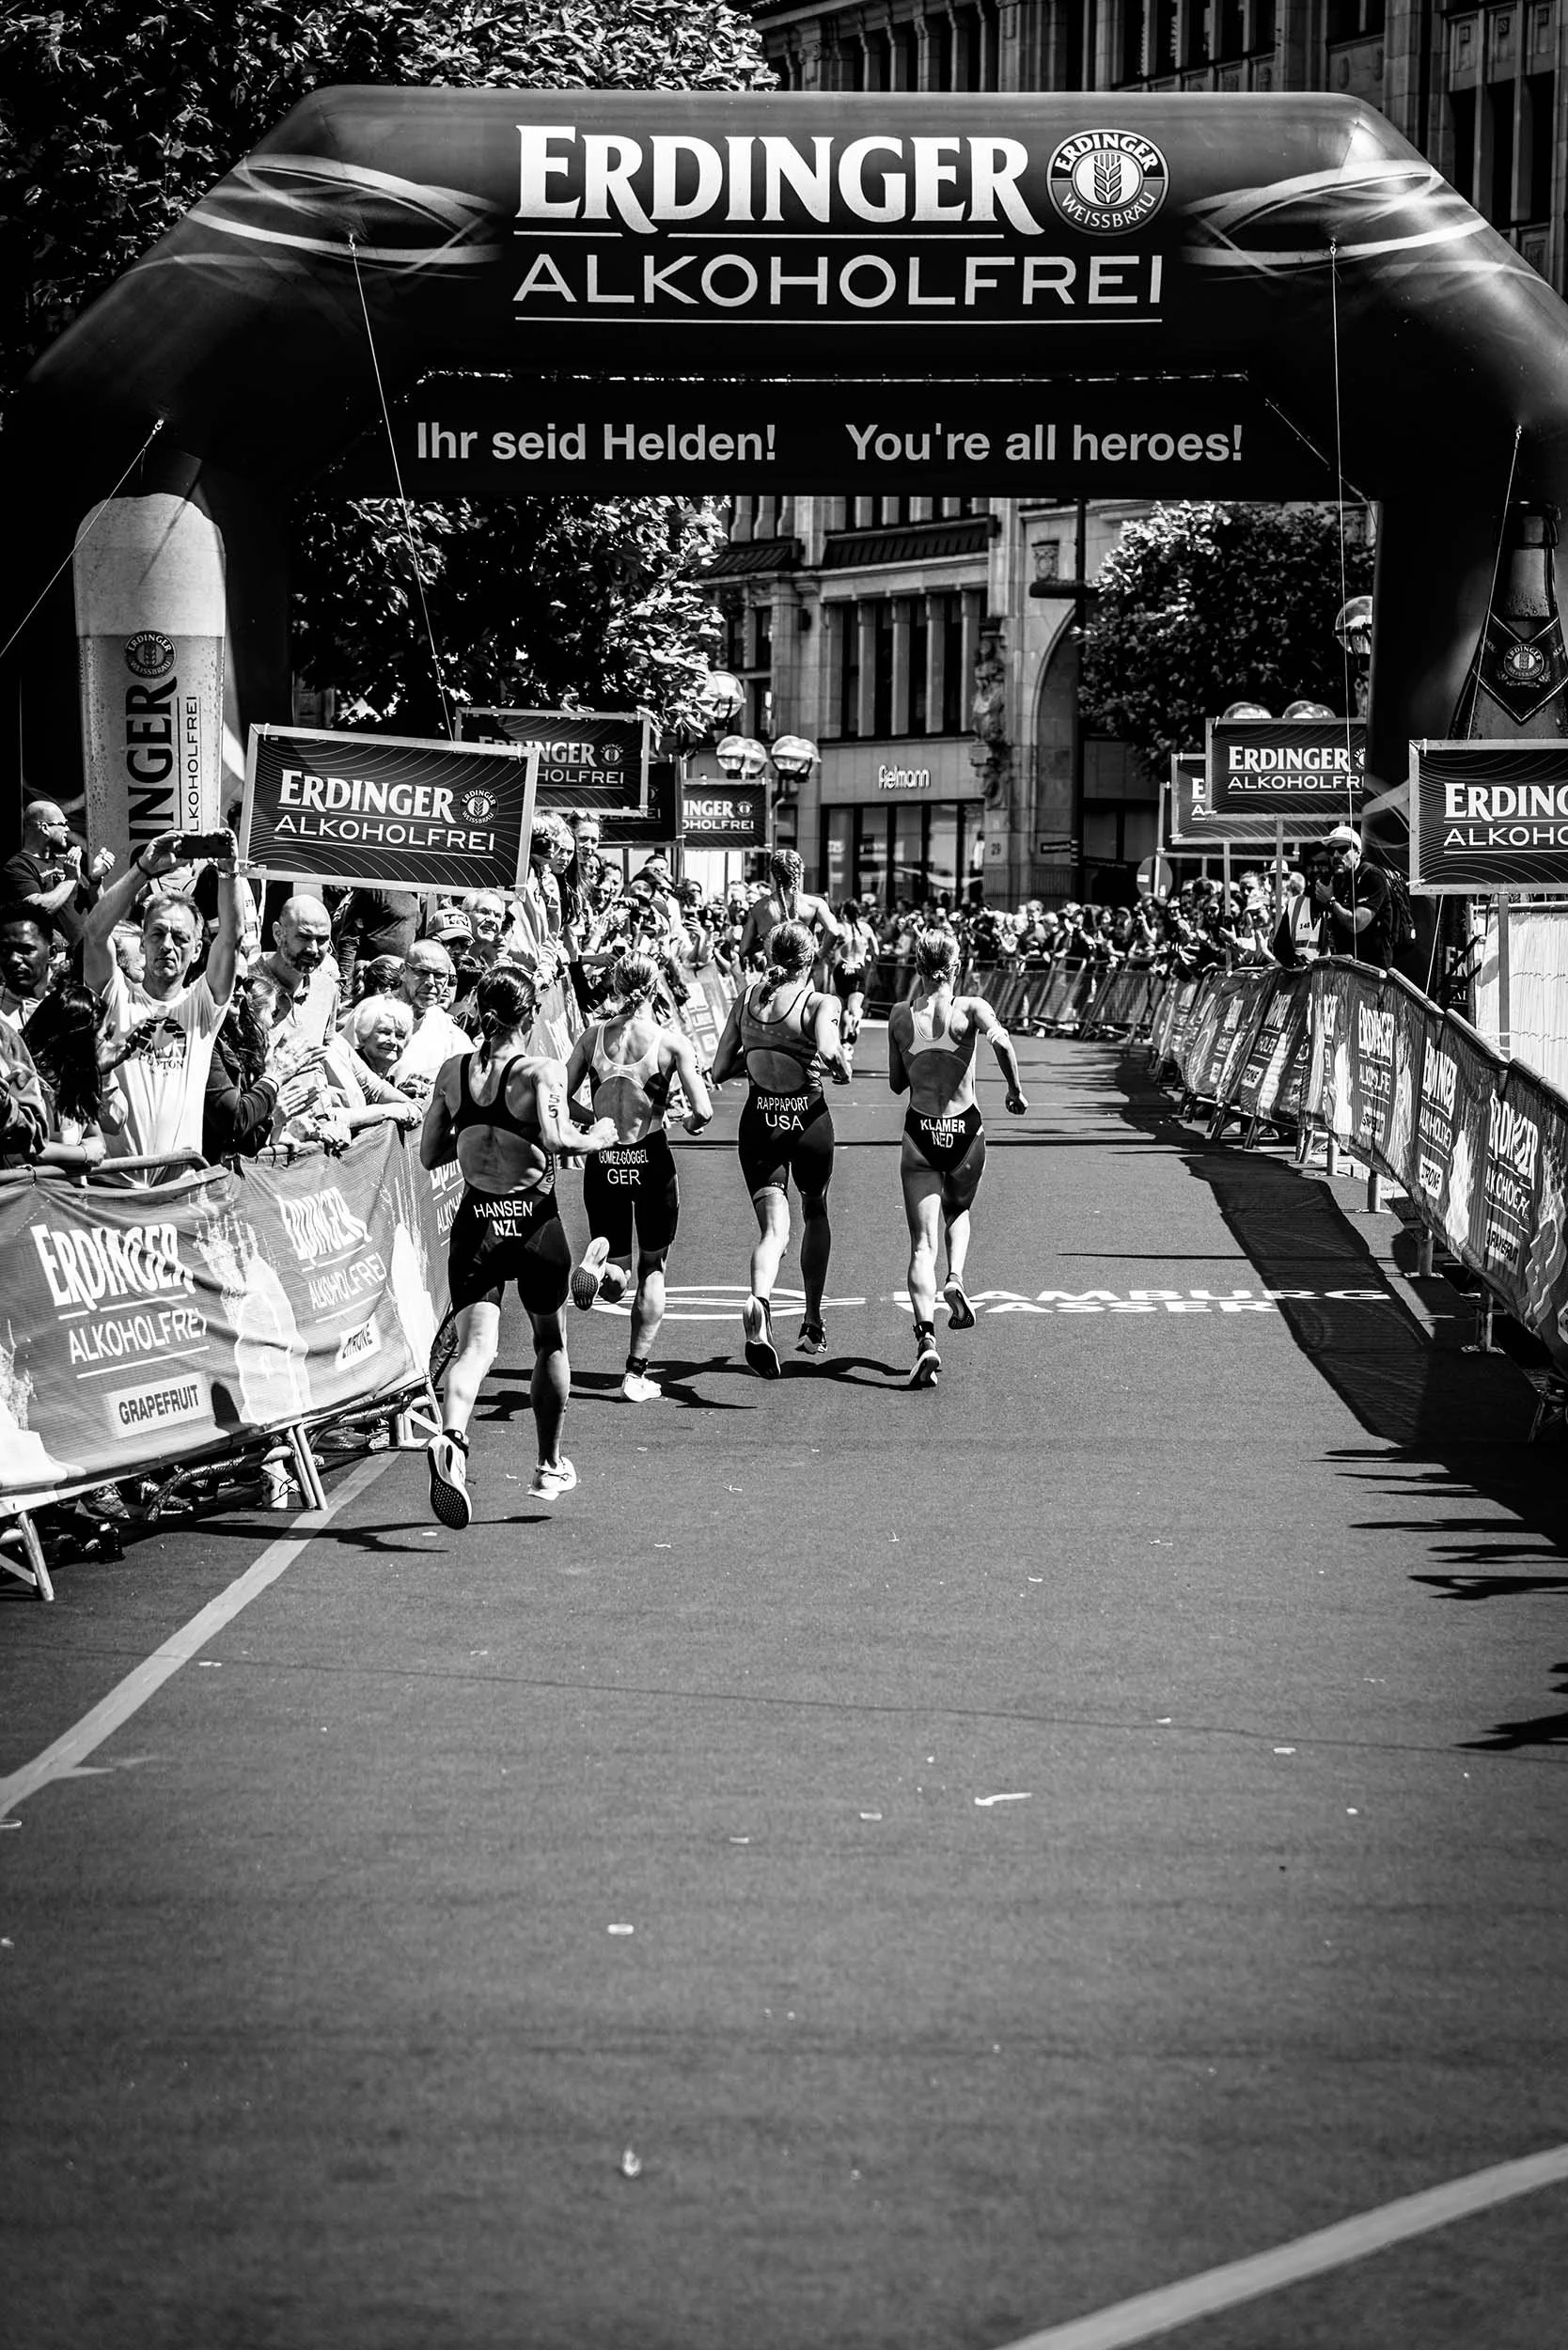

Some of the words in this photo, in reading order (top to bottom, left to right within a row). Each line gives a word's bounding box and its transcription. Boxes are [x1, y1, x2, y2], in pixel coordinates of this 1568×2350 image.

[1055, 133, 1159, 172] ERDINGER
[515, 125, 1044, 235] ERDINGER
[1062, 192, 1155, 228] WEISSBRÄU
[513, 254, 1163, 308] ALKOHOLFREI
[417, 422, 478, 460] Ihr
[492, 423, 586, 461] seid
[604, 423, 776, 461] Helden!
[845, 422, 991, 461] You're
[1005, 424, 1056, 461] all
[1074, 424, 1243, 461] heroes!
[128, 634, 172, 651] ERDINGER
[1229, 746, 1352, 773] ERDINGER
[279, 769, 456, 824] ERDINGER
[1228, 776, 1364, 790] ALKOHOLFR
[462, 790, 496, 806] ERDINGER
[274, 814, 494, 851] ALKOHOLFREI
[757, 1096, 808, 1112] RAPPAPORT
[765, 1113, 805, 1131] USA
[920, 1119, 966, 1134] KLAMER
[932, 1131, 954, 1148] NED
[607, 1168, 641, 1184] GER
[474, 1200, 533, 1218] HANSEN
[493, 1220, 523, 1237] NZL
[30, 1223, 196, 1310] ERDINGER
[69, 1308, 208, 1365] ALKOHOLFREI
[118, 1384, 199, 1425] GRAPEFRUIT
